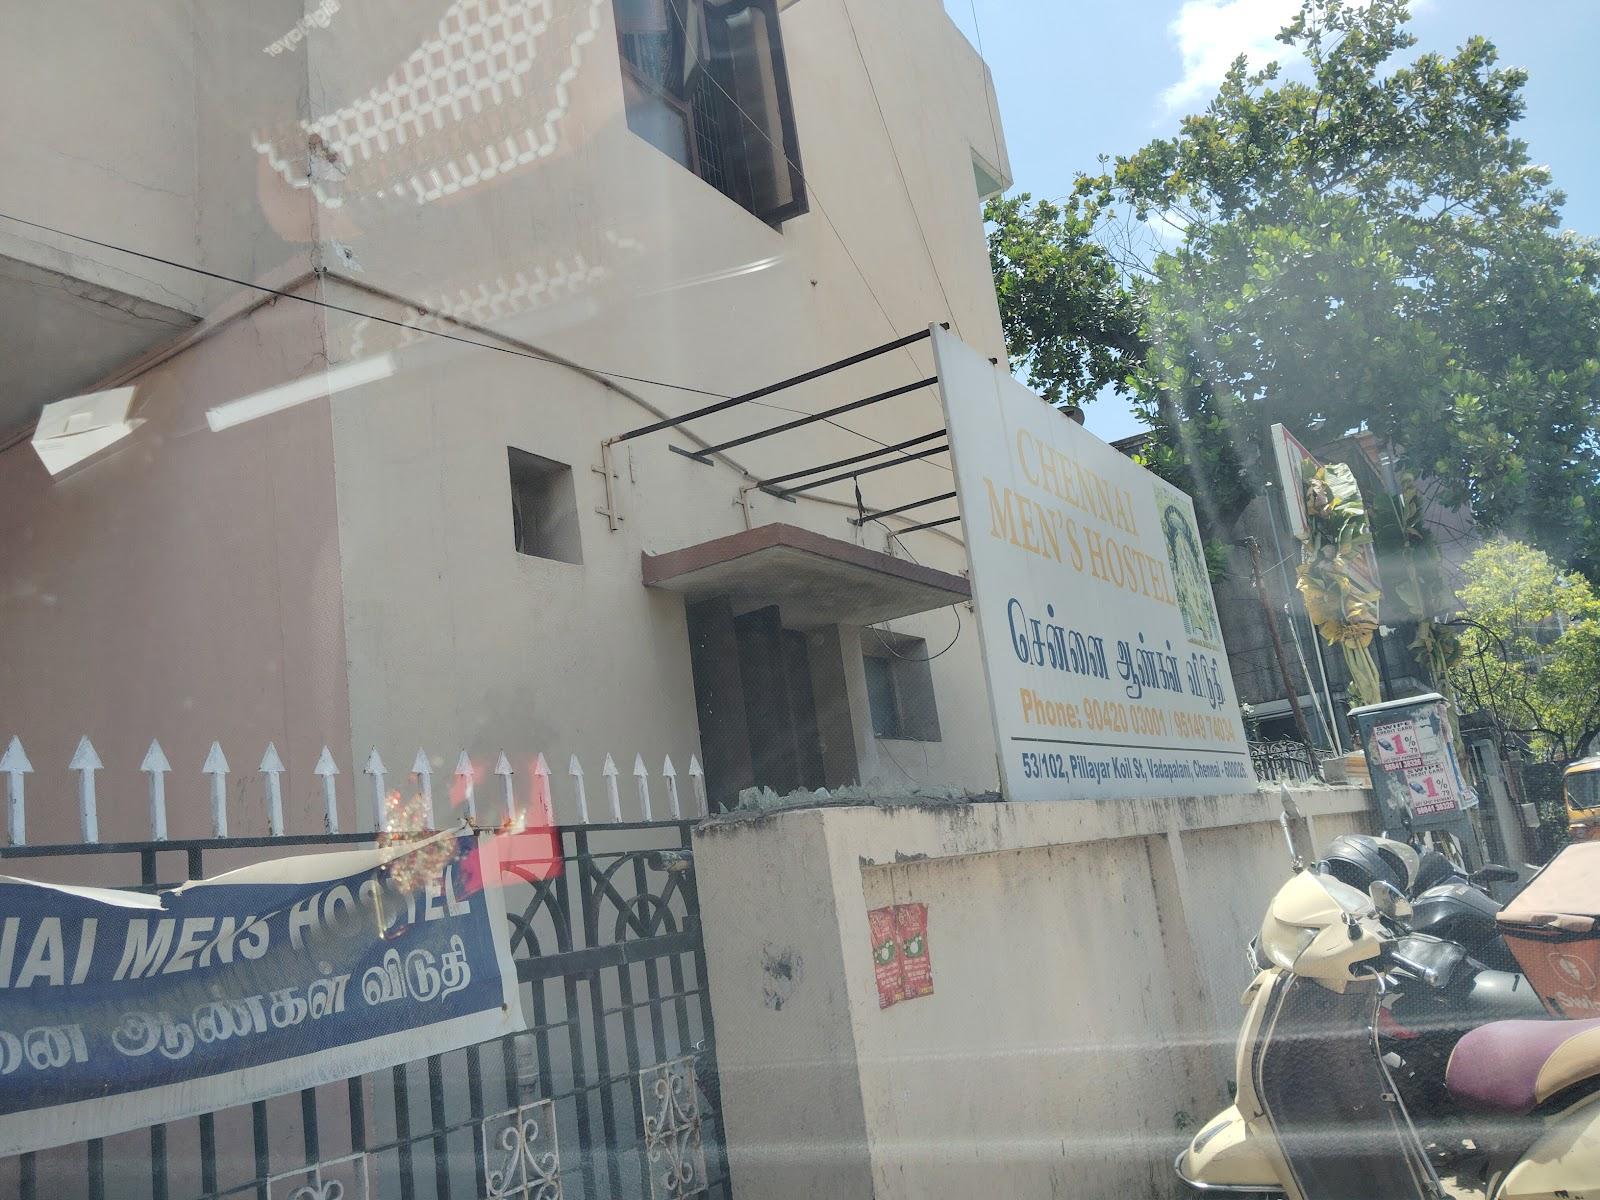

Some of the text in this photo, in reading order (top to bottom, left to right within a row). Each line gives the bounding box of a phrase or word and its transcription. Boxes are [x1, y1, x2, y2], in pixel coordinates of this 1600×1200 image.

[1017, 427, 1139, 537] CHENNAI
[984, 477, 1177, 607] MEN'S HOSTEL
[1007, 597, 1110, 680] சென்னை
[1116, 632, 1183, 699] ஆண்கள்
[1019, 687, 1081, 728] Phone:
[1082, 698, 1129, 733] 90420
[1130, 705, 1167, 736] 03001
[1376, 721, 1411, 731] SWIPE
[1022, 753, 1070, 783] 53/102,
[1069, 755, 1111, 784] Pillayar
[1111, 757, 1133, 779] Koil
[1132, 758, 1148, 782] St,
[1192, 760, 1221, 778] Chennai
[1407, 764, 1441, 775] SWIPE
[111, 960, 351, 1060] ஆண்கள்
[362, 934, 471, 1005] விடுதி
